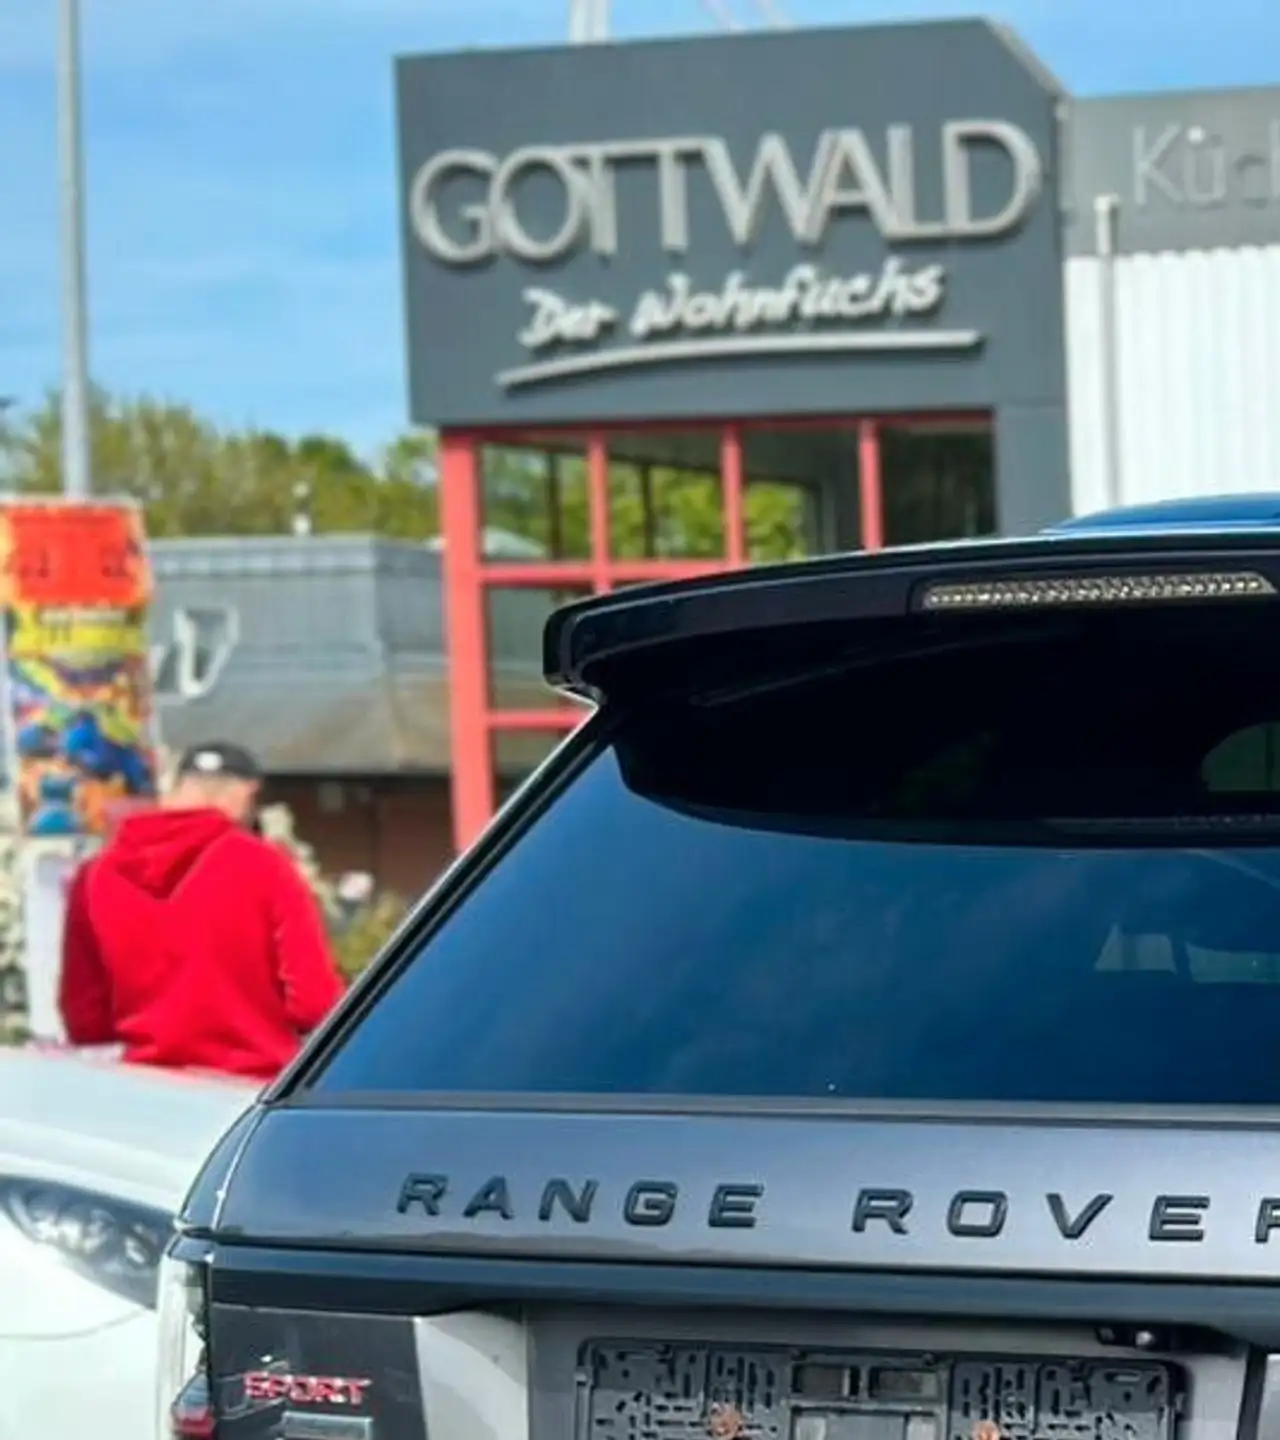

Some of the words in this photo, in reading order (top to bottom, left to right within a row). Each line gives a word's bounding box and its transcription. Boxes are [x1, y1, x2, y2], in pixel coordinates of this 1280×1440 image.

[412, 120, 1040, 262] GOTTWALD
[518, 287, 616, 348] Der
[630, 253, 944, 338] Wohnfuchs
[398, 1172, 764, 1229] RANGE
[241, 1370, 372, 1405] SPORT
